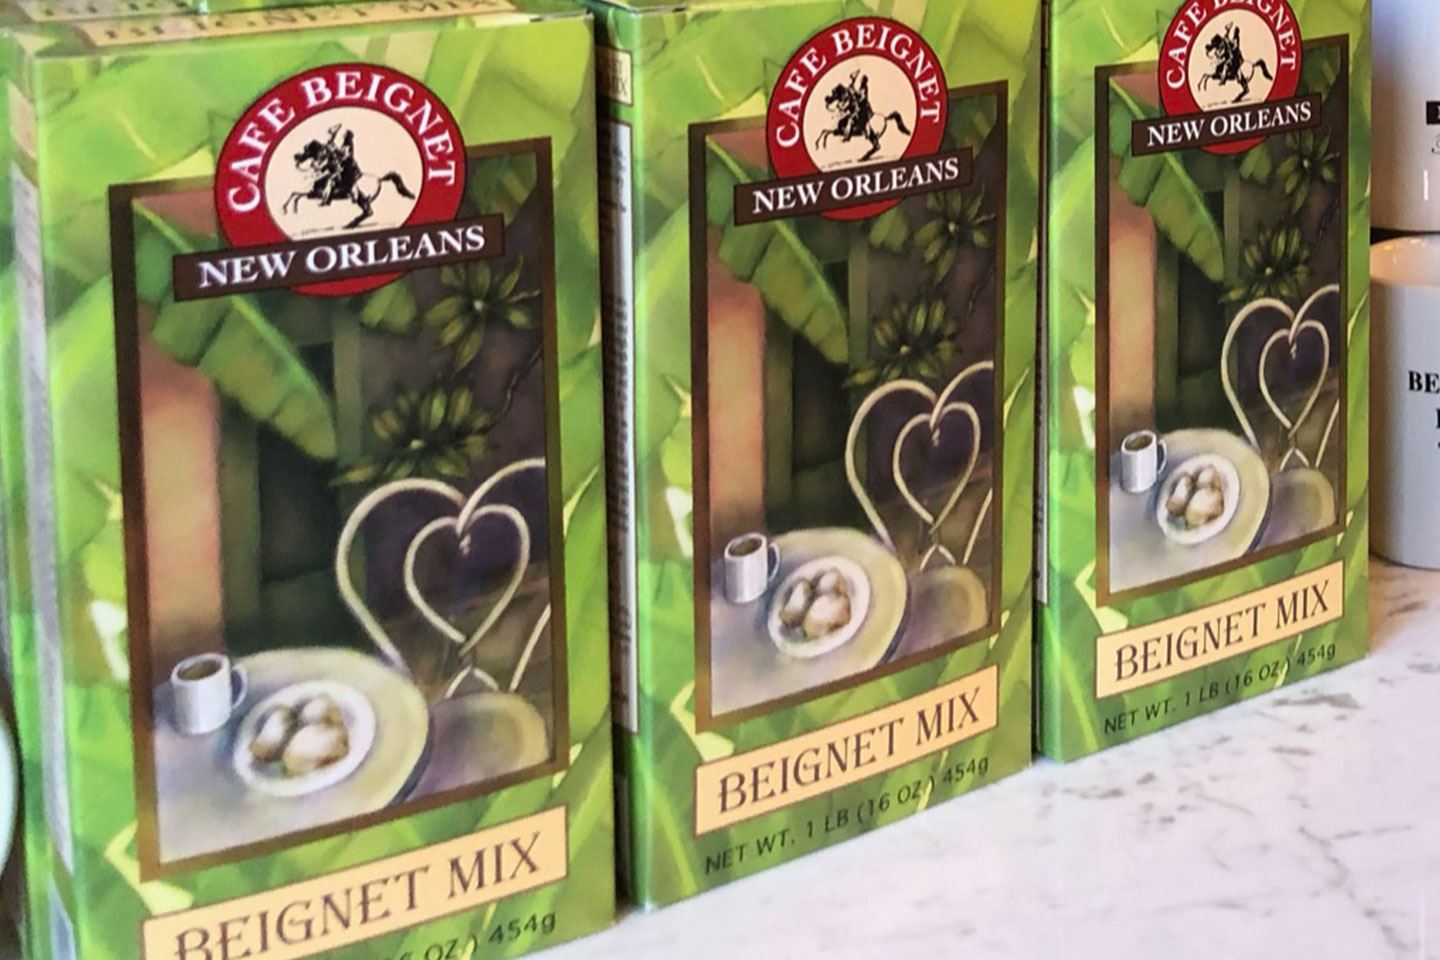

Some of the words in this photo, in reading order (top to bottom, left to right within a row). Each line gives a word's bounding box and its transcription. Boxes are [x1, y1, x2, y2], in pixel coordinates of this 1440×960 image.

[776, 47, 827, 148] CAFE
[831, 24, 941, 123] BEIGNET
[1166, 1, 1207, 89] CAFE
[228, 97, 296, 213] CAFE
[300, 71, 457, 186] BEIGNET
[1147, 118, 1204, 148] NEW
[1210, 101, 1312, 137] ORLEANS
[752, 181, 824, 214] NEW
[831, 157, 959, 200] ORLEANS
[199, 251, 298, 289] NEW
[306, 225, 485, 274] ORLEANS
[1114, 603, 1266, 682] BEIGNET
[1275, 579, 1330, 630] MIX
[1104, 709, 1140, 735] NET
[1144, 699, 1177, 722] WT.
[1185, 691, 1191, 707] 1
[1199, 682, 1219, 703] LB
[1225, 669, 1253, 695] (16
[1297, 643, 1336, 666] 454g
[717, 718, 905, 815] BEIGNET
[916, 686, 981, 746] MIX
[704, 844, 749, 875] NET
[756, 829, 796, 856] WT.
[807, 820, 814, 838] 1
[824, 812, 849, 834] LB
[857, 795, 890, 825] (16
[942, 756, 989, 784] 454g
[174, 864, 430, 960] BEIGNET
[447, 831, 542, 899] MIX
[488, 913, 556, 944] 454g
